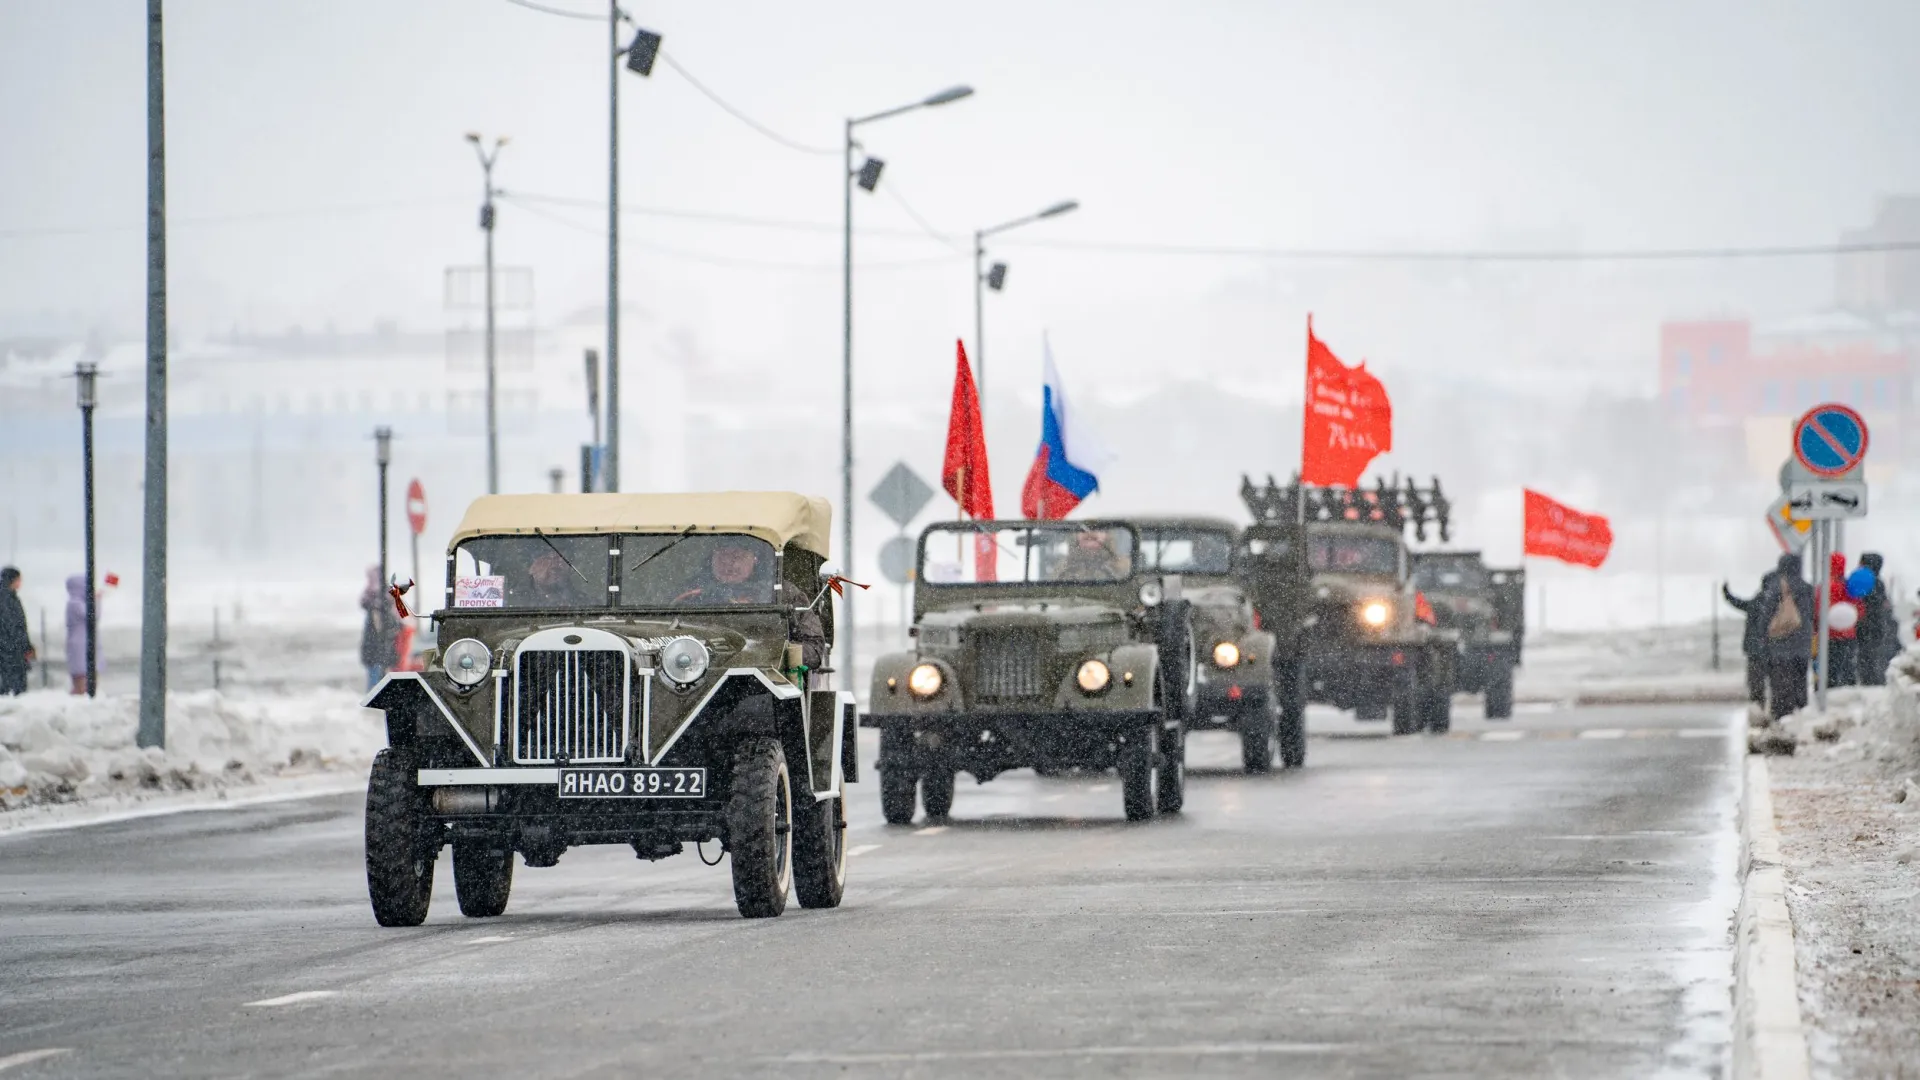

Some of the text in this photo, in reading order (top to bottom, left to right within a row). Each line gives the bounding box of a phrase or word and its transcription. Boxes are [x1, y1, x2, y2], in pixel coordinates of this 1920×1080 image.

[459, 599, 497, 607] ПРОПУСК
[563, 773, 701, 793] ЯНАО 89-22
